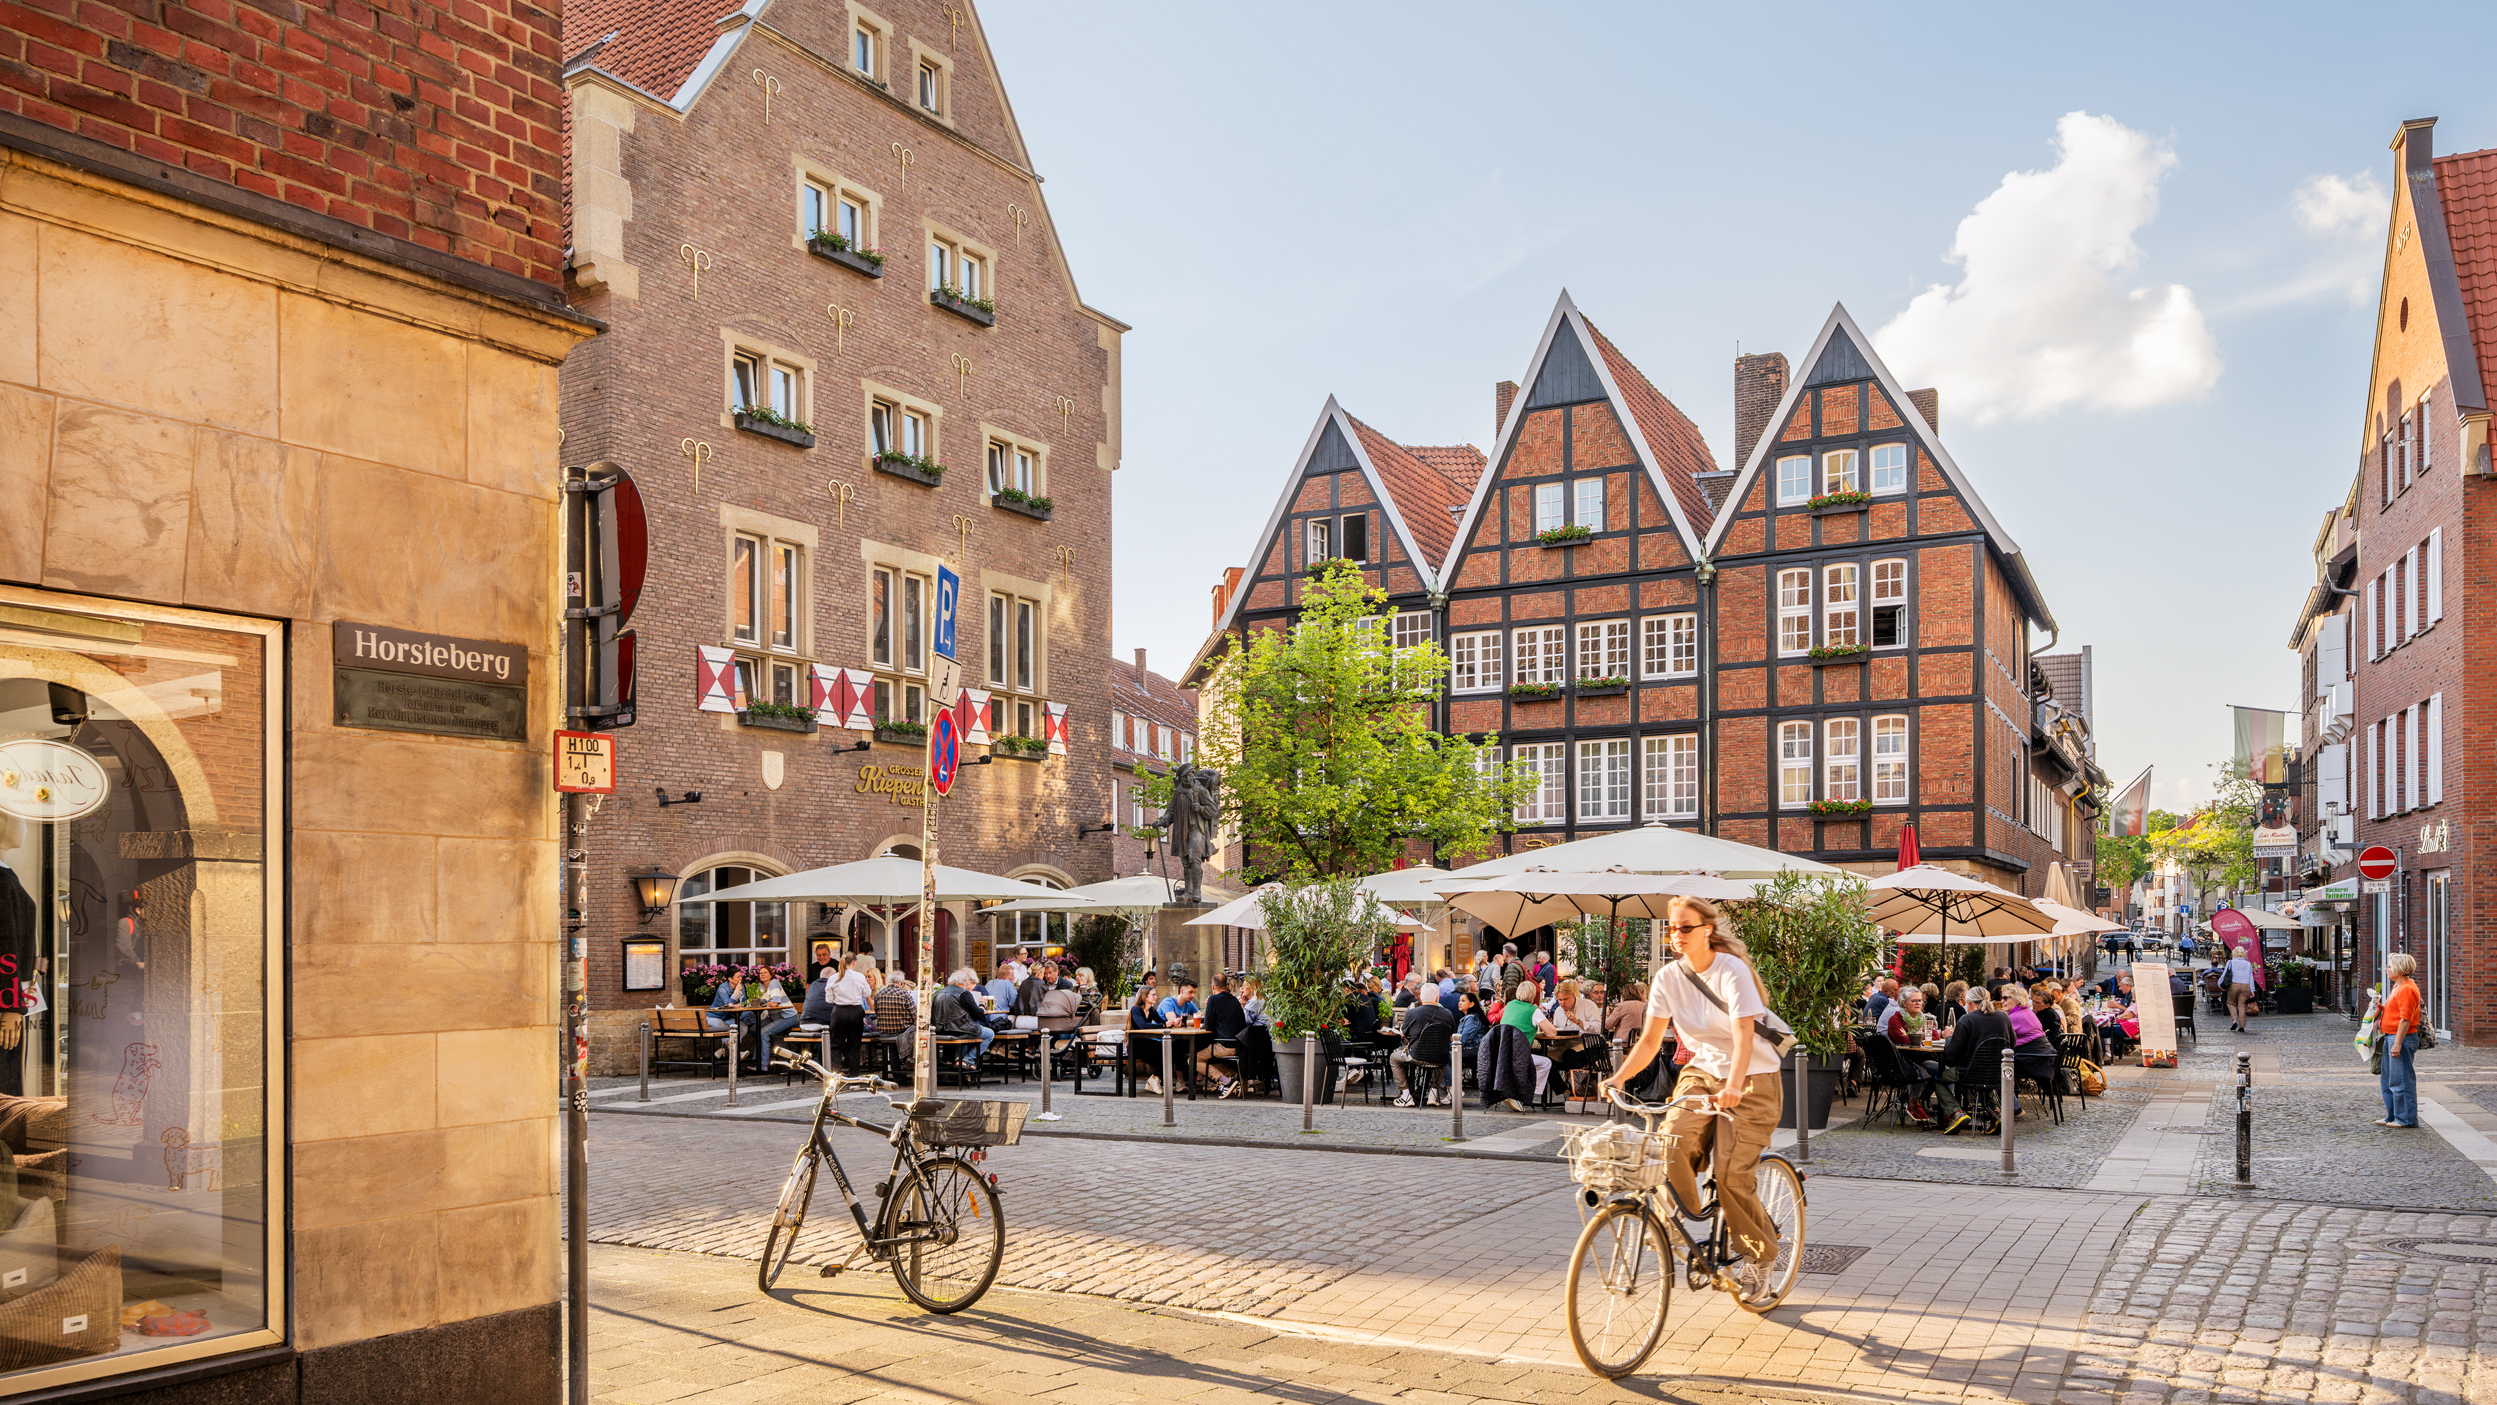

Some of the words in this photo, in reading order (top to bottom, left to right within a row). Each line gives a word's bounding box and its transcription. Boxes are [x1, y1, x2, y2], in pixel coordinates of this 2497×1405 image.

[940, 578, 952, 644] P
[355, 630, 511, 680] Horsteberg
[402, 697, 445, 713] Torturm
[450, 703, 467, 714] der
[367, 706, 447, 726] Karolingischen
[451, 716, 500, 733] Domburg
[569, 737, 599, 752] H100
[889, 765, 924, 777] GROSSER
[826, 1154, 847, 1188] PEGASUS
